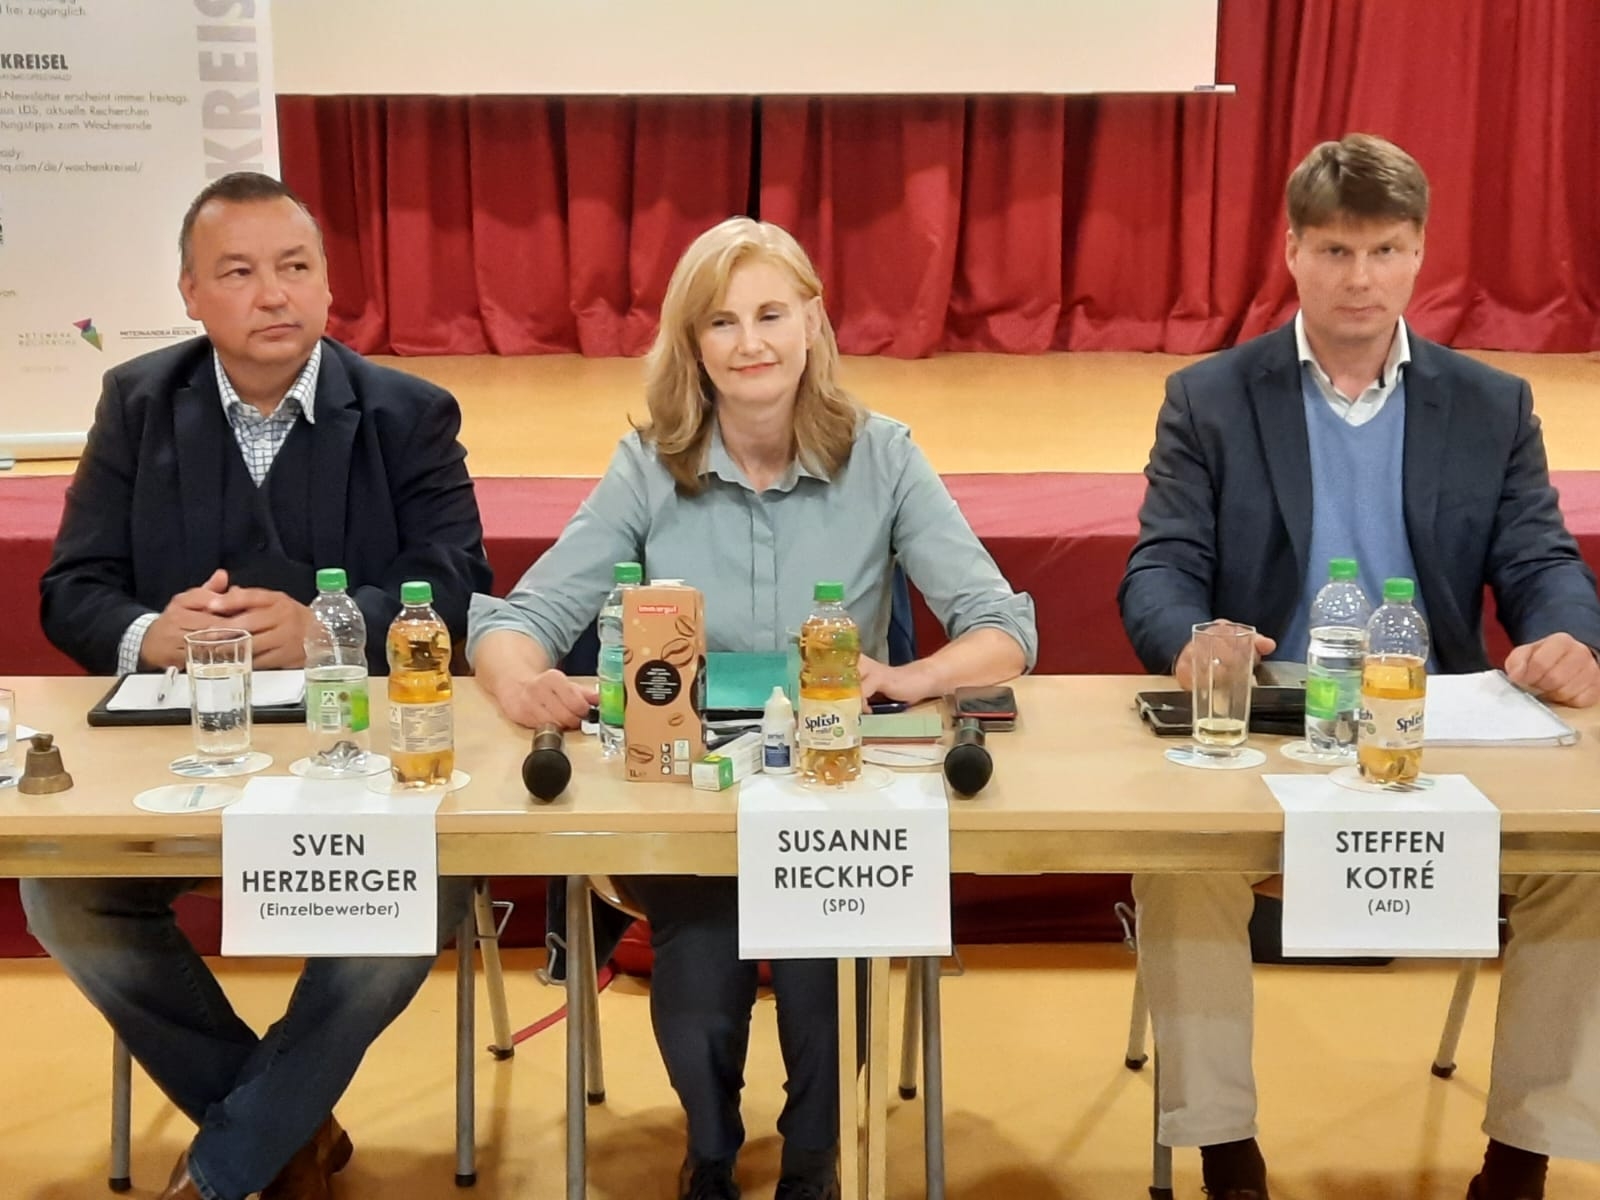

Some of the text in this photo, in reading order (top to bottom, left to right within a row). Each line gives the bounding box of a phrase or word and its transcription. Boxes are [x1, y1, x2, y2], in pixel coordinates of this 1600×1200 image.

[0, 53, 69, 70] KREISEL
[46, 104, 87, 115] aktuelle
[89, 105, 149, 116] Recherchen
[82, 119, 152, 130] Wochenende
[292, 833, 365, 856] SVEN
[777, 828, 908, 852] SUSANNE
[1335, 830, 1445, 853] STEFFEN
[242, 869, 418, 892] HERZBERGER
[774, 864, 914, 889] RIECKHOF
[1346, 860, 1435, 889] KOTRÉ
[259, 901, 400, 920] (Einzelbewerber)
[822, 898, 866, 915] (SPD)
[1367, 898, 1411, 916] (AfD)
